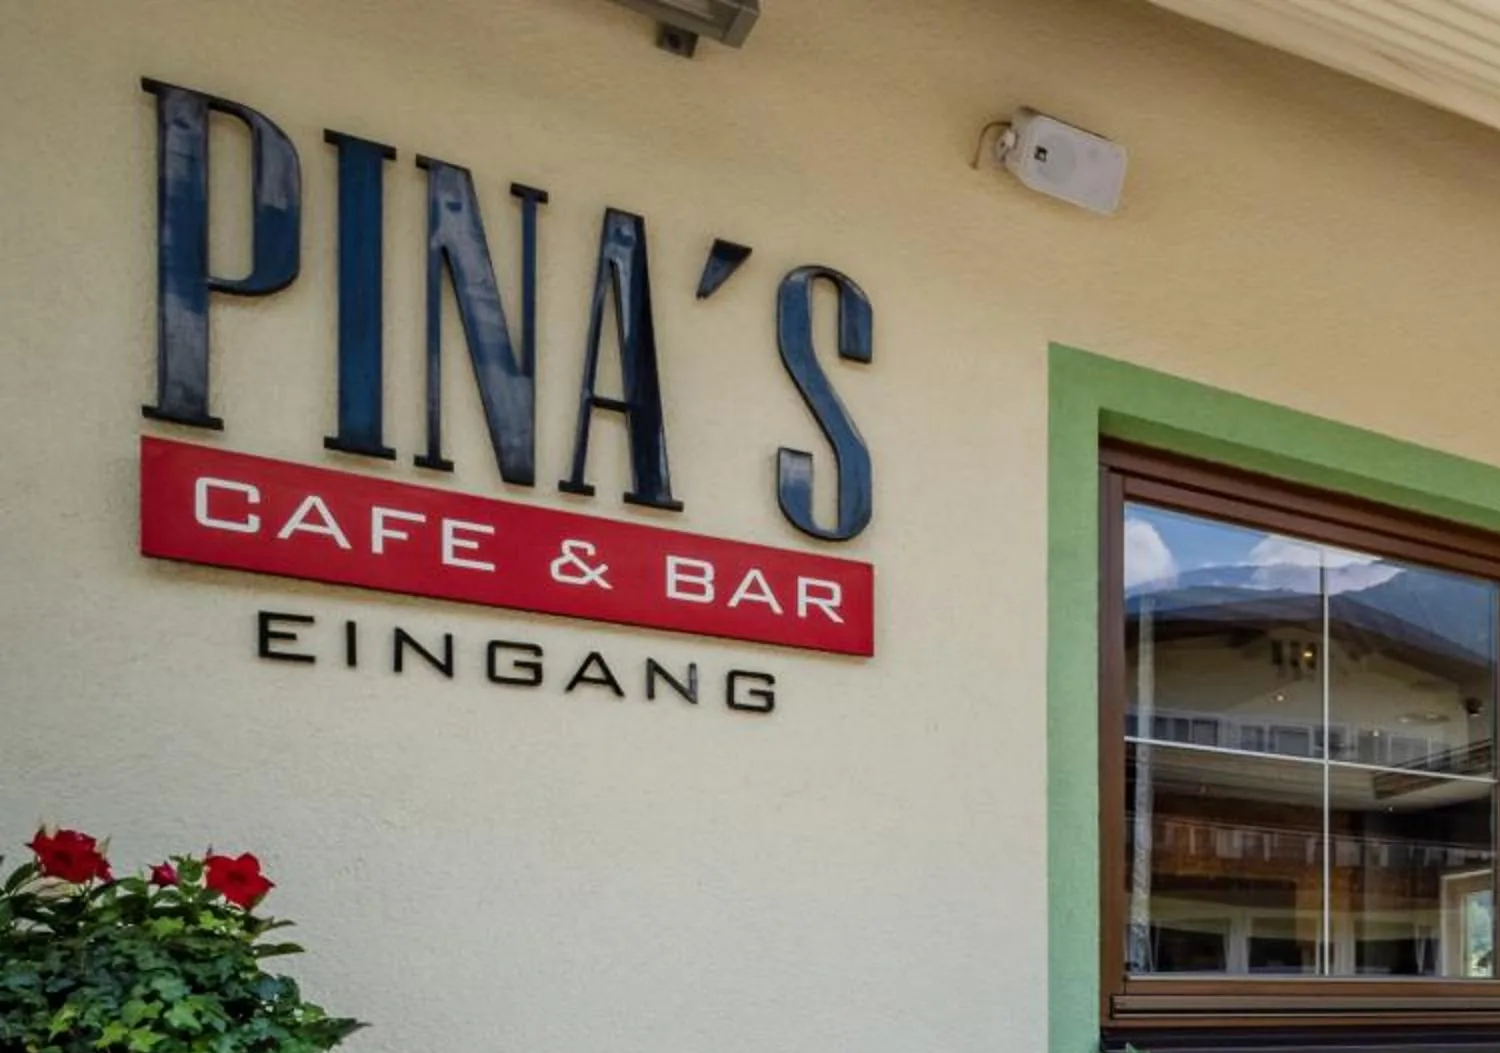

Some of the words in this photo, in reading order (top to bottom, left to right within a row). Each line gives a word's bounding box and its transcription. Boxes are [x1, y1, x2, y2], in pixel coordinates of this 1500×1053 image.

[193, 476, 496, 572] CAFE
[549, 538, 613, 590] &
[664, 554, 845, 624] BAR
[257, 610, 777, 714] EINGANG
